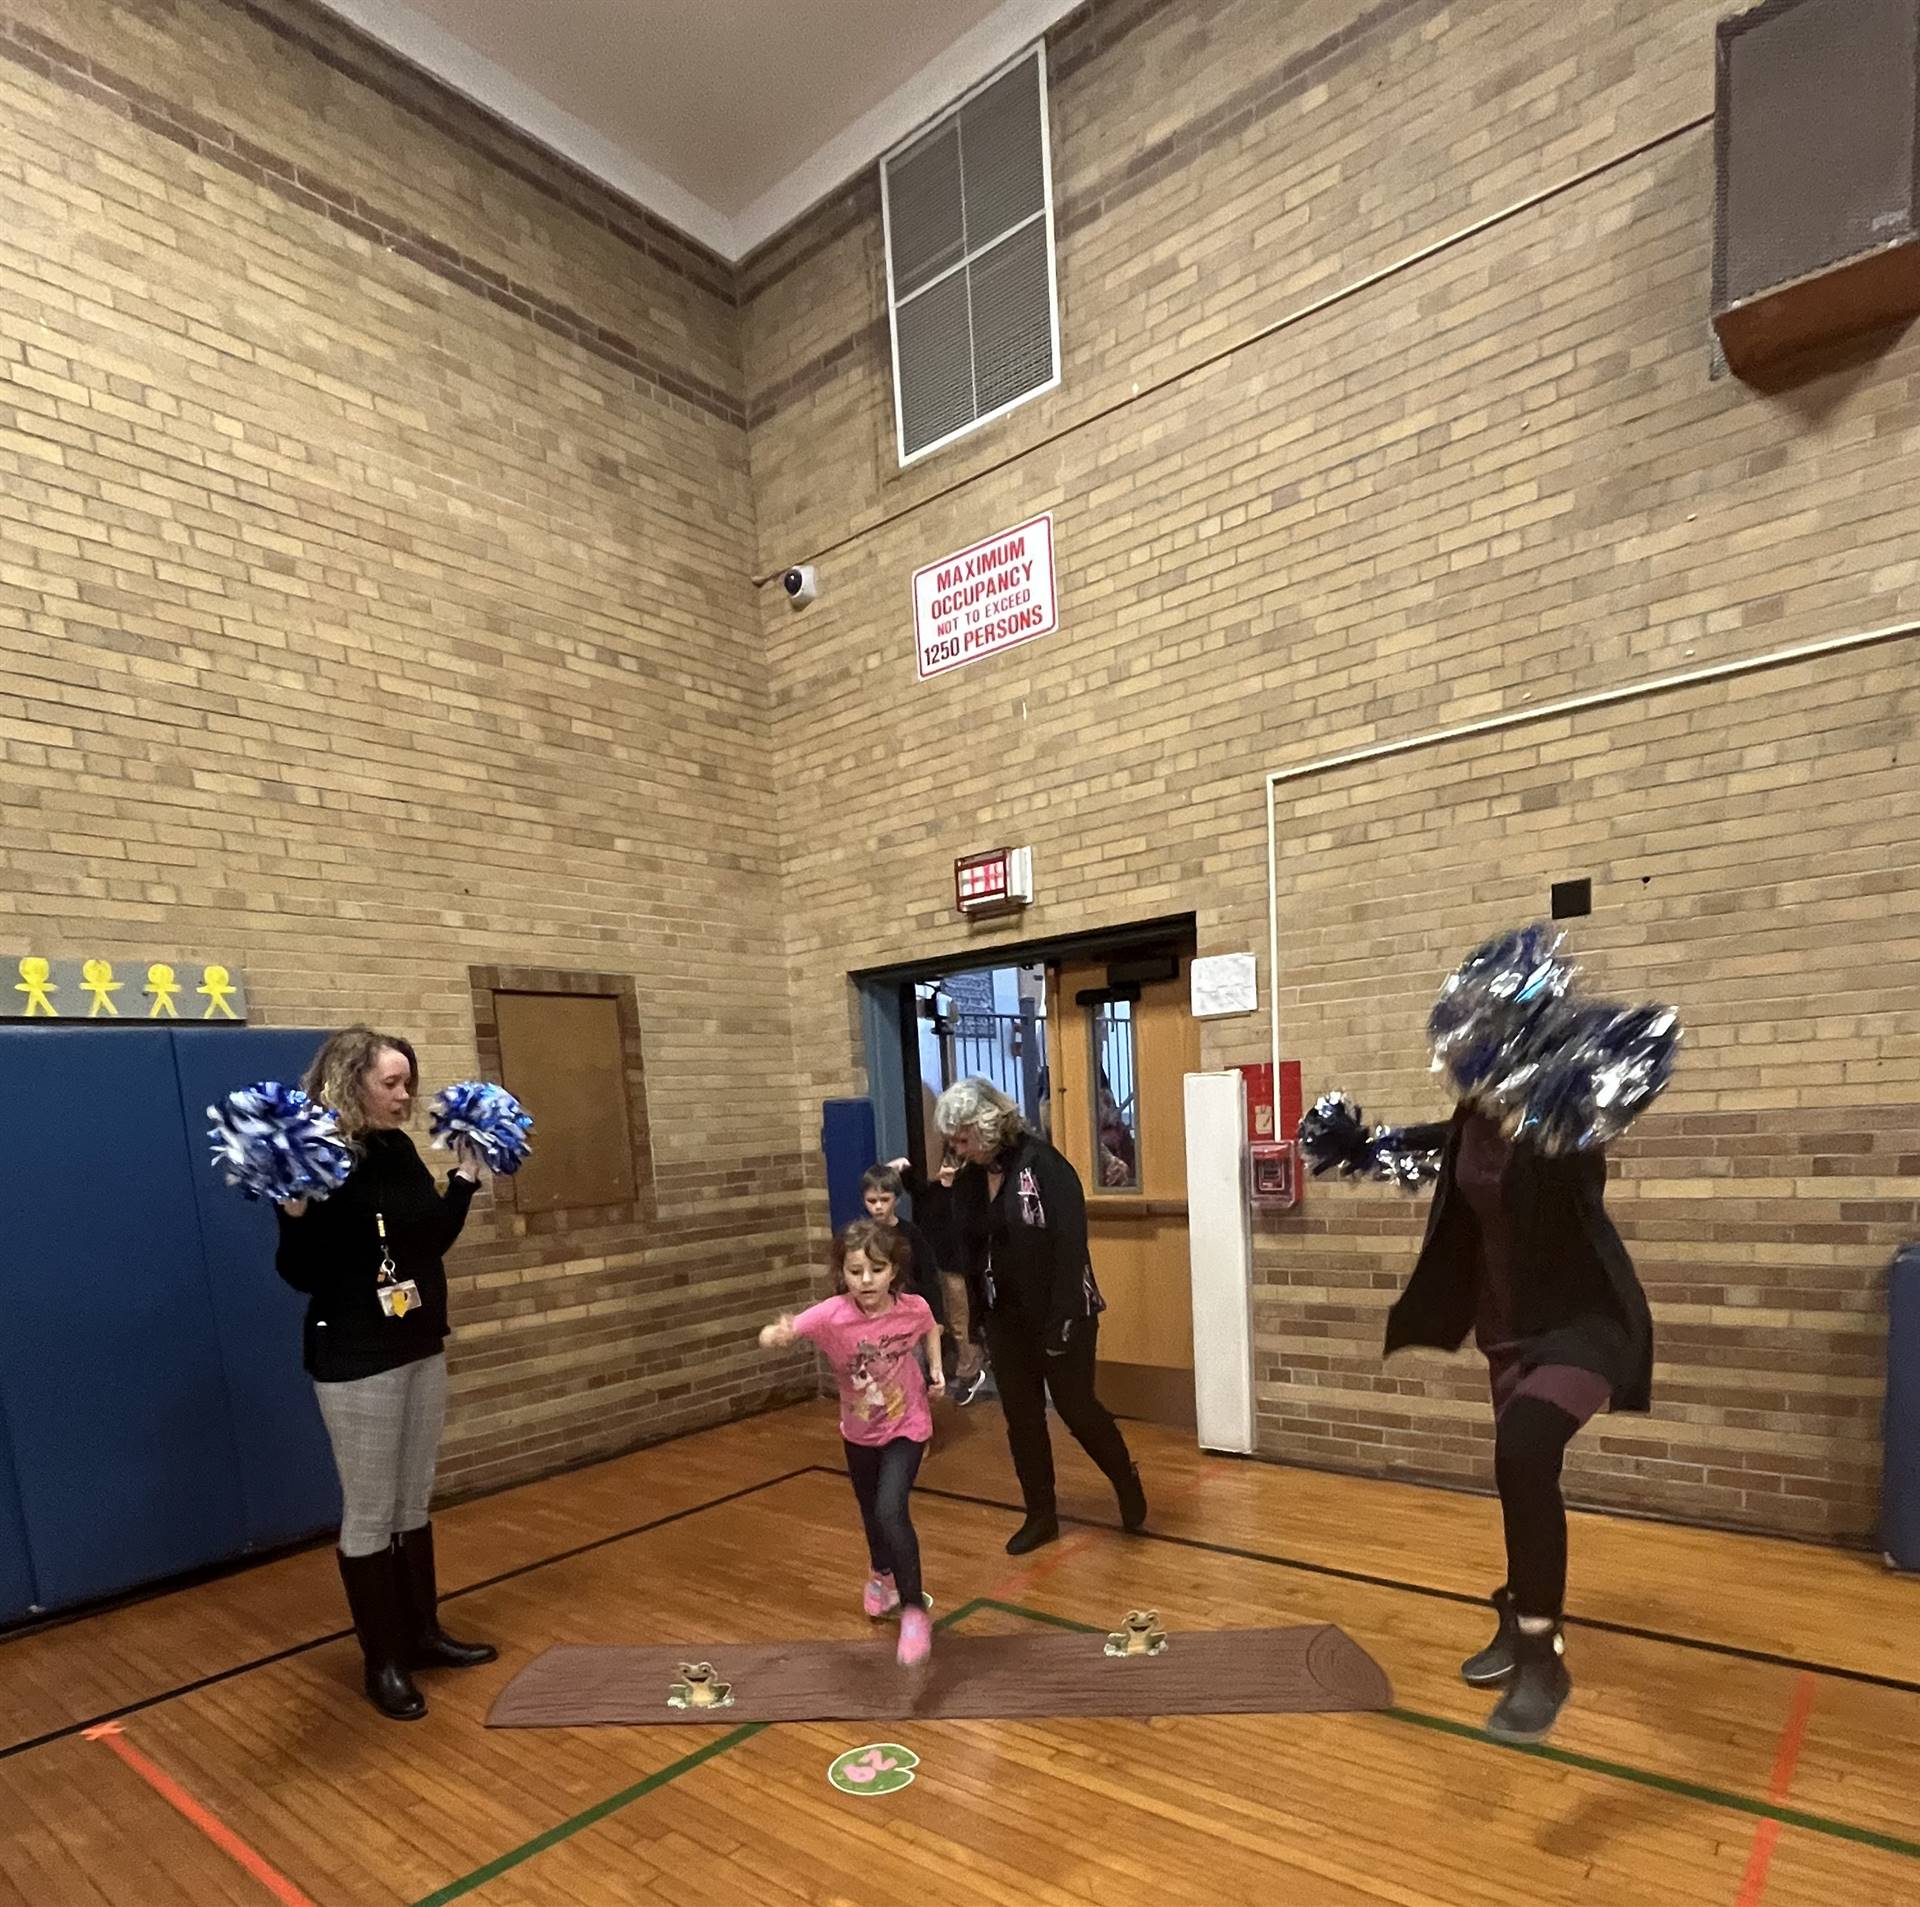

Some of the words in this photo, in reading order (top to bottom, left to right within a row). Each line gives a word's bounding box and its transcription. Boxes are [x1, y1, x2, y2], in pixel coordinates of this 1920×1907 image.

[931, 560, 1033, 620] OCCUPANCY
[937, 537, 1025, 593] MAXIMUM
[924, 637, 960, 666] 1250
[964, 605, 1043, 652] PERSONS
[937, 618, 959, 637] NOT
[966, 609, 981, 626] TO
[985, 589, 1031, 618] EXCEED
